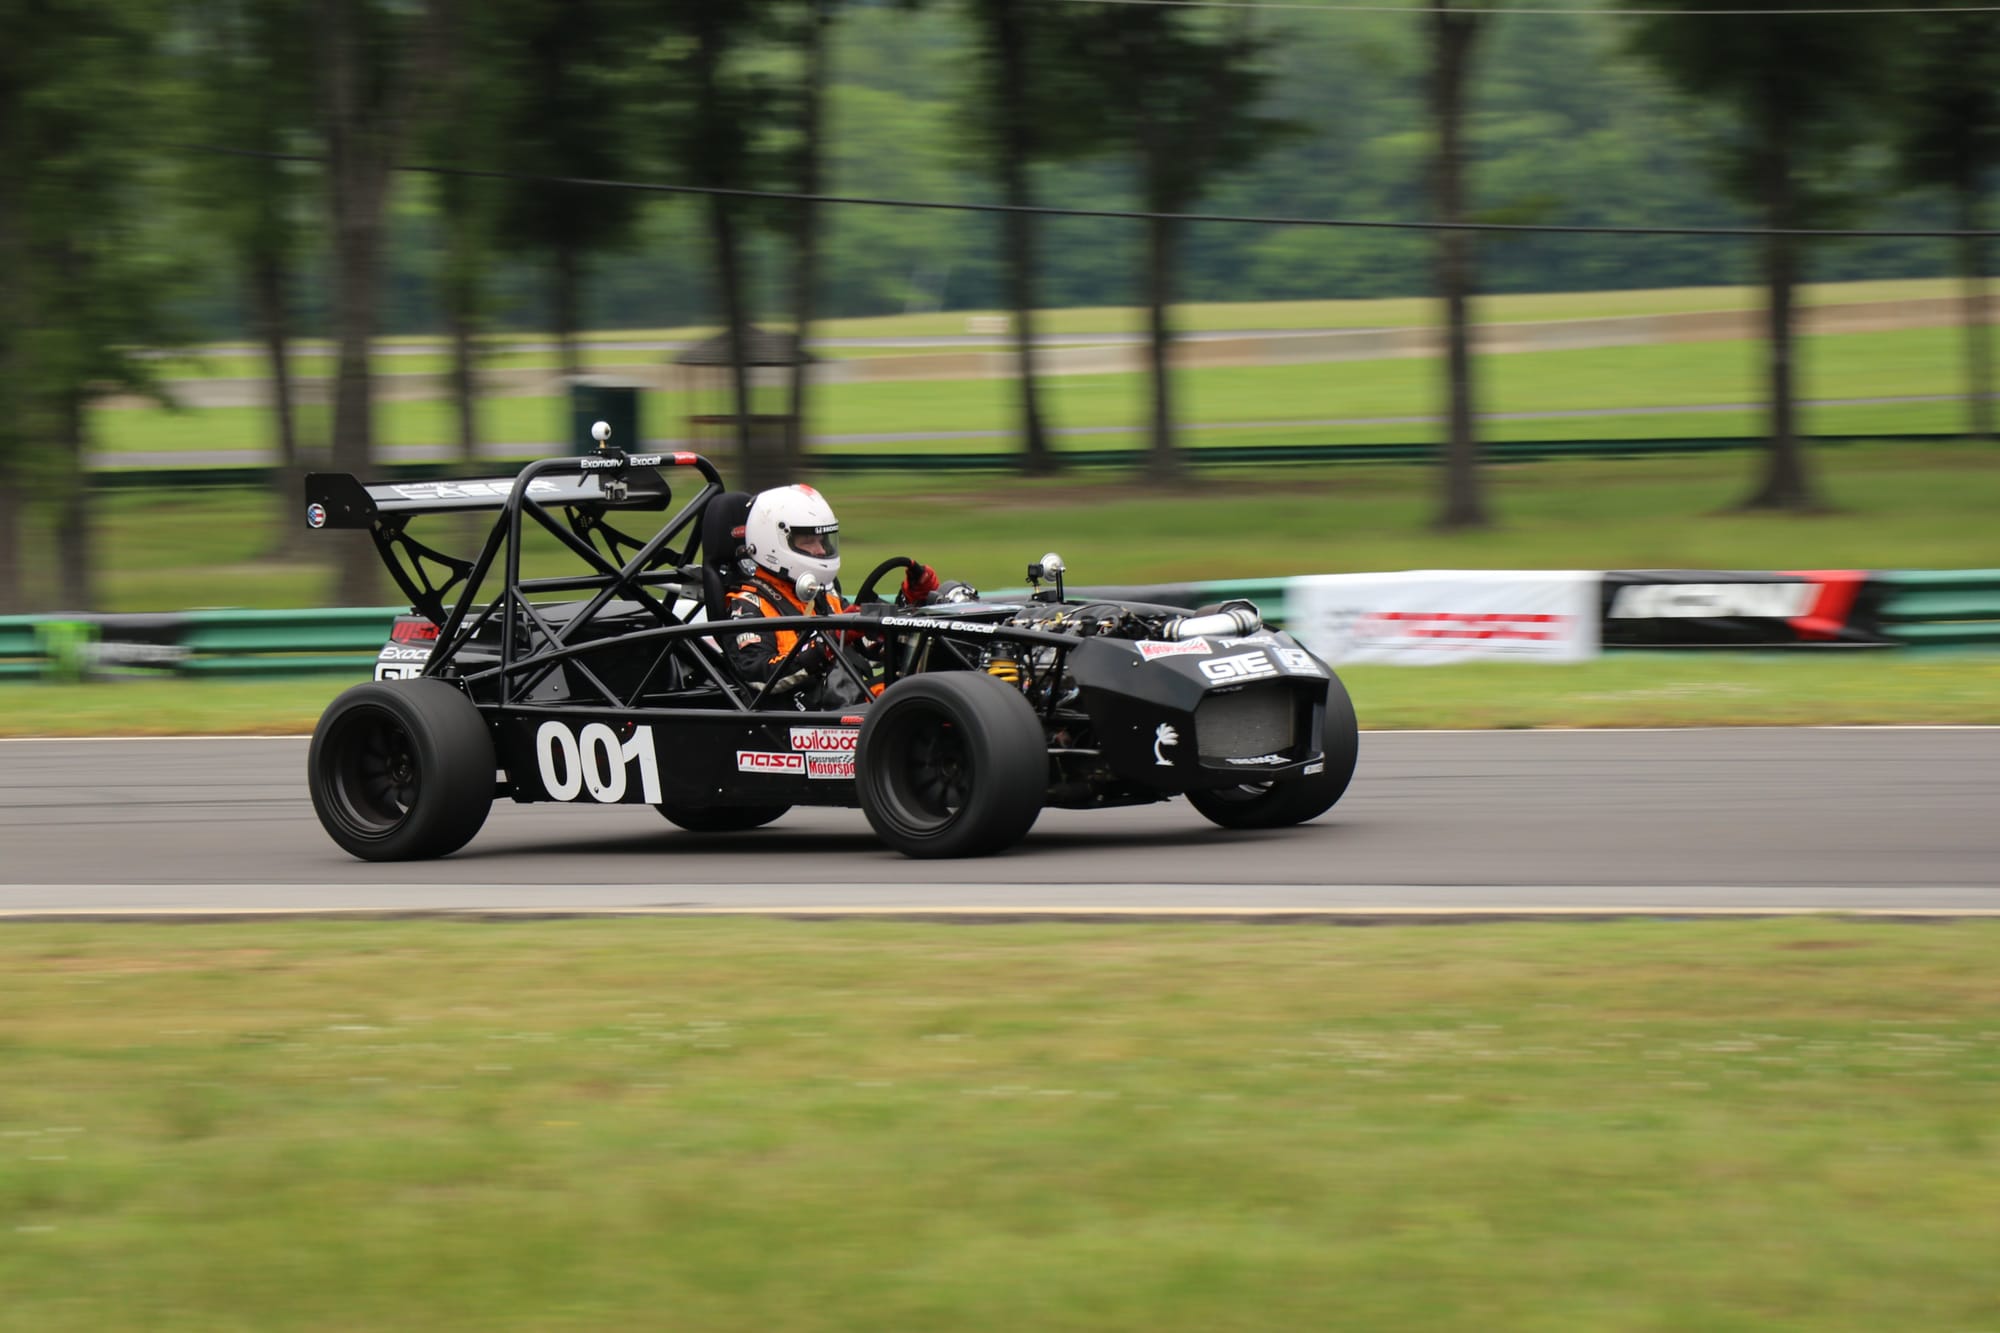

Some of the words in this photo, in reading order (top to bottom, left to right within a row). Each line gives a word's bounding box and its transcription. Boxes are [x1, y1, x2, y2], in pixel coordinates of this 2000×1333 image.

[581, 458, 623, 469] Exomotiv
[630, 456, 661, 466] Exocet
[881, 616, 949, 629] Exomotive
[951, 621, 998, 633] Exocet
[1199, 651, 1274, 679] GTE
[792, 730, 859, 750] wilwoo
[536, 720, 663, 804] 001
[808, 761, 857, 776] Motorspo
